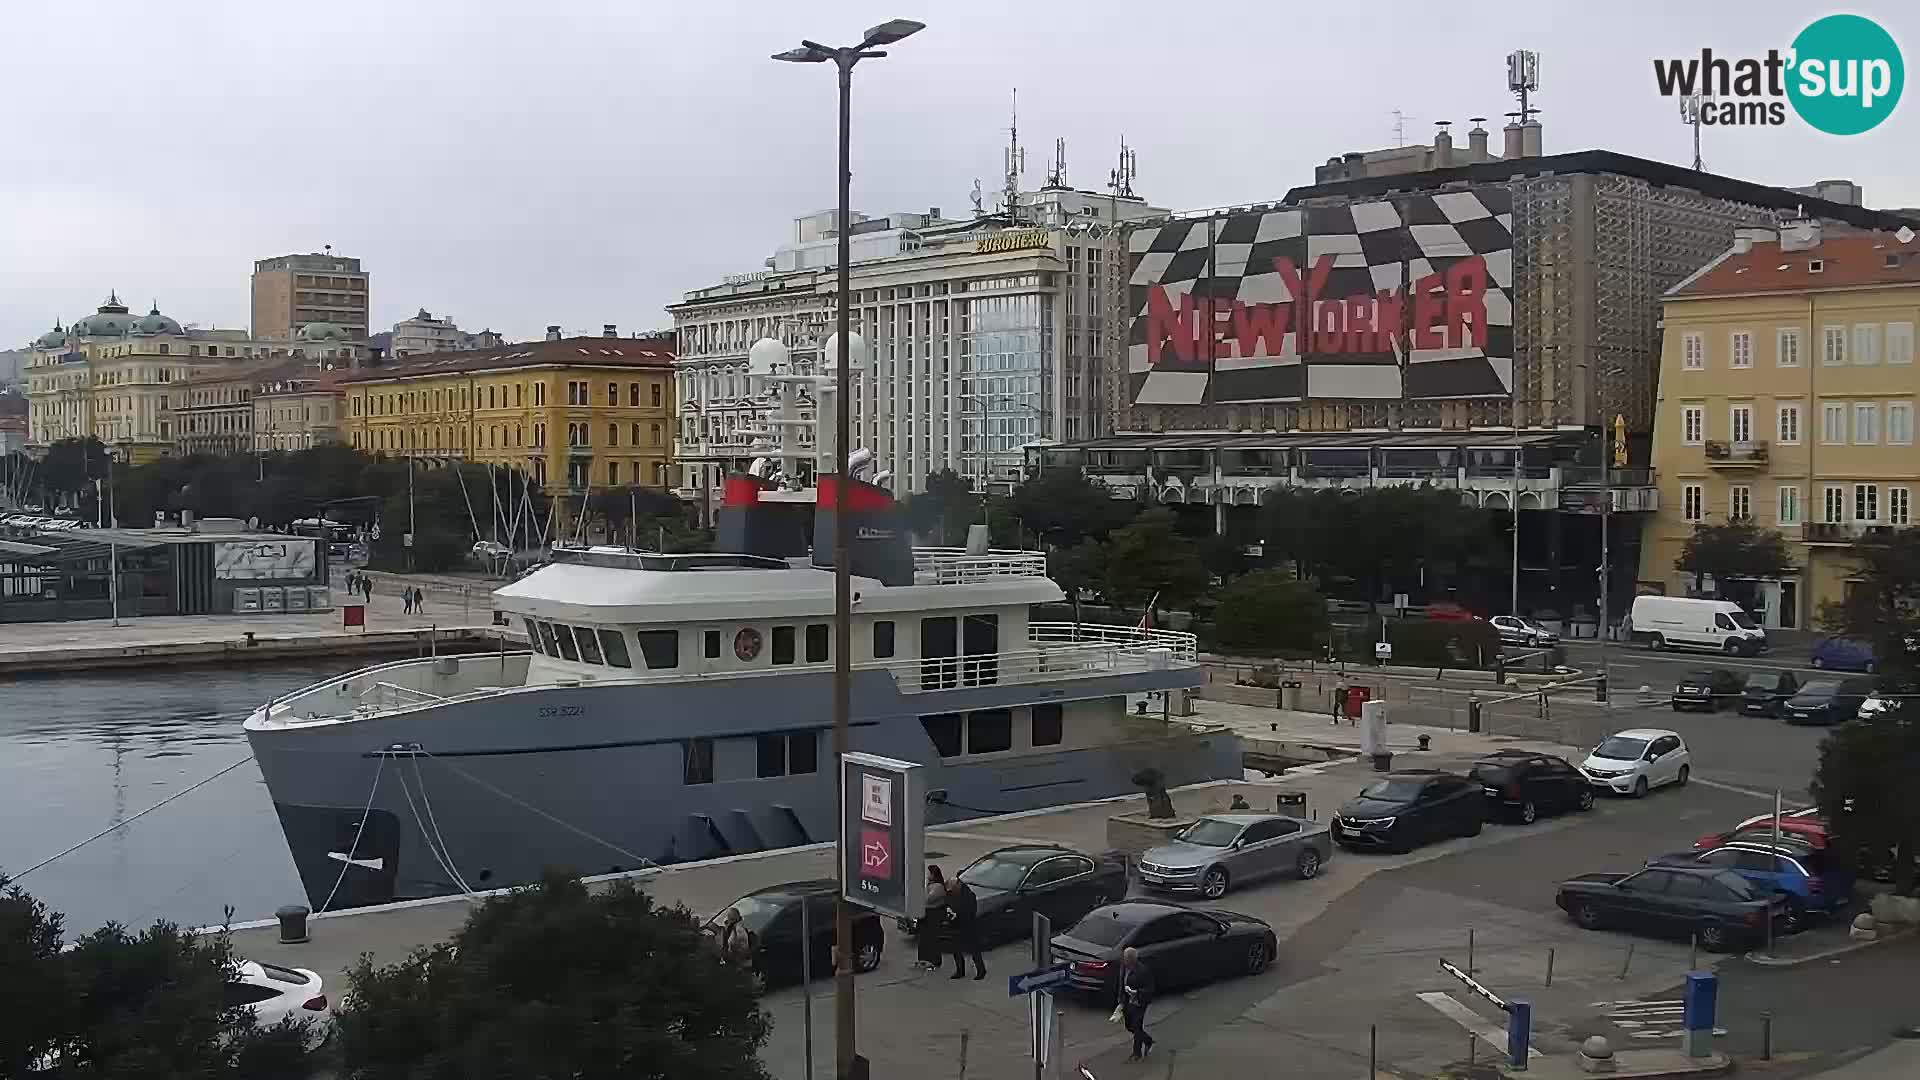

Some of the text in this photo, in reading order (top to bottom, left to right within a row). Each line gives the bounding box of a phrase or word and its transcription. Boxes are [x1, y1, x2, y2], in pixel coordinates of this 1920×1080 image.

[1147, 255, 1488, 364] NEW YORKER
[861, 879, 867, 890] 5
